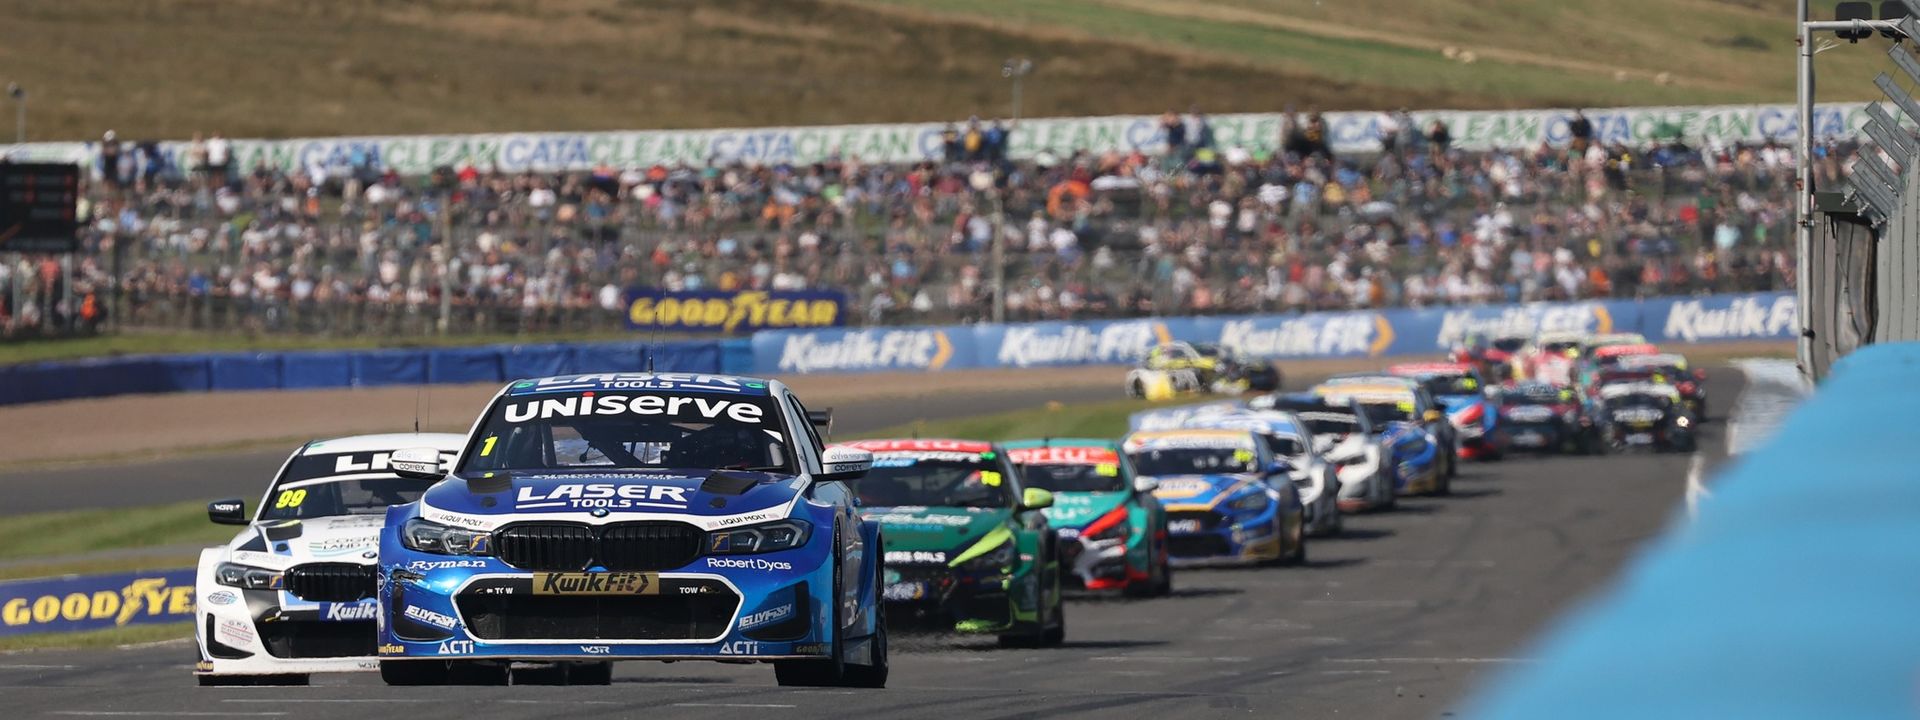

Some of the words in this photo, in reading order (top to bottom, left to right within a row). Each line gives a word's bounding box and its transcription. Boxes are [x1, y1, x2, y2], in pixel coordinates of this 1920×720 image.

[503, 132, 704, 169] CATACLEAN
[629, 291, 839, 331] GOODYEAR
[601, 380, 674, 389] TOOLS
[480, 436, 498, 456] 1
[276, 489, 306, 508] 99
[517, 484, 688, 502] LASER
[570, 499, 632, 508] TOOLS
[440, 514, 461, 523] LIQUI
[462, 518, 484, 527] MOLY
[719, 518, 743, 526] LIQUI
[744, 513, 767, 522] MOLY
[409, 560, 487, 570] Ryman
[707, 558, 756, 569] Robert
[757, 559, 793, 571] Dyas
[2, 578, 196, 626] GOODYE
[327, 602, 377, 621] Kwik
